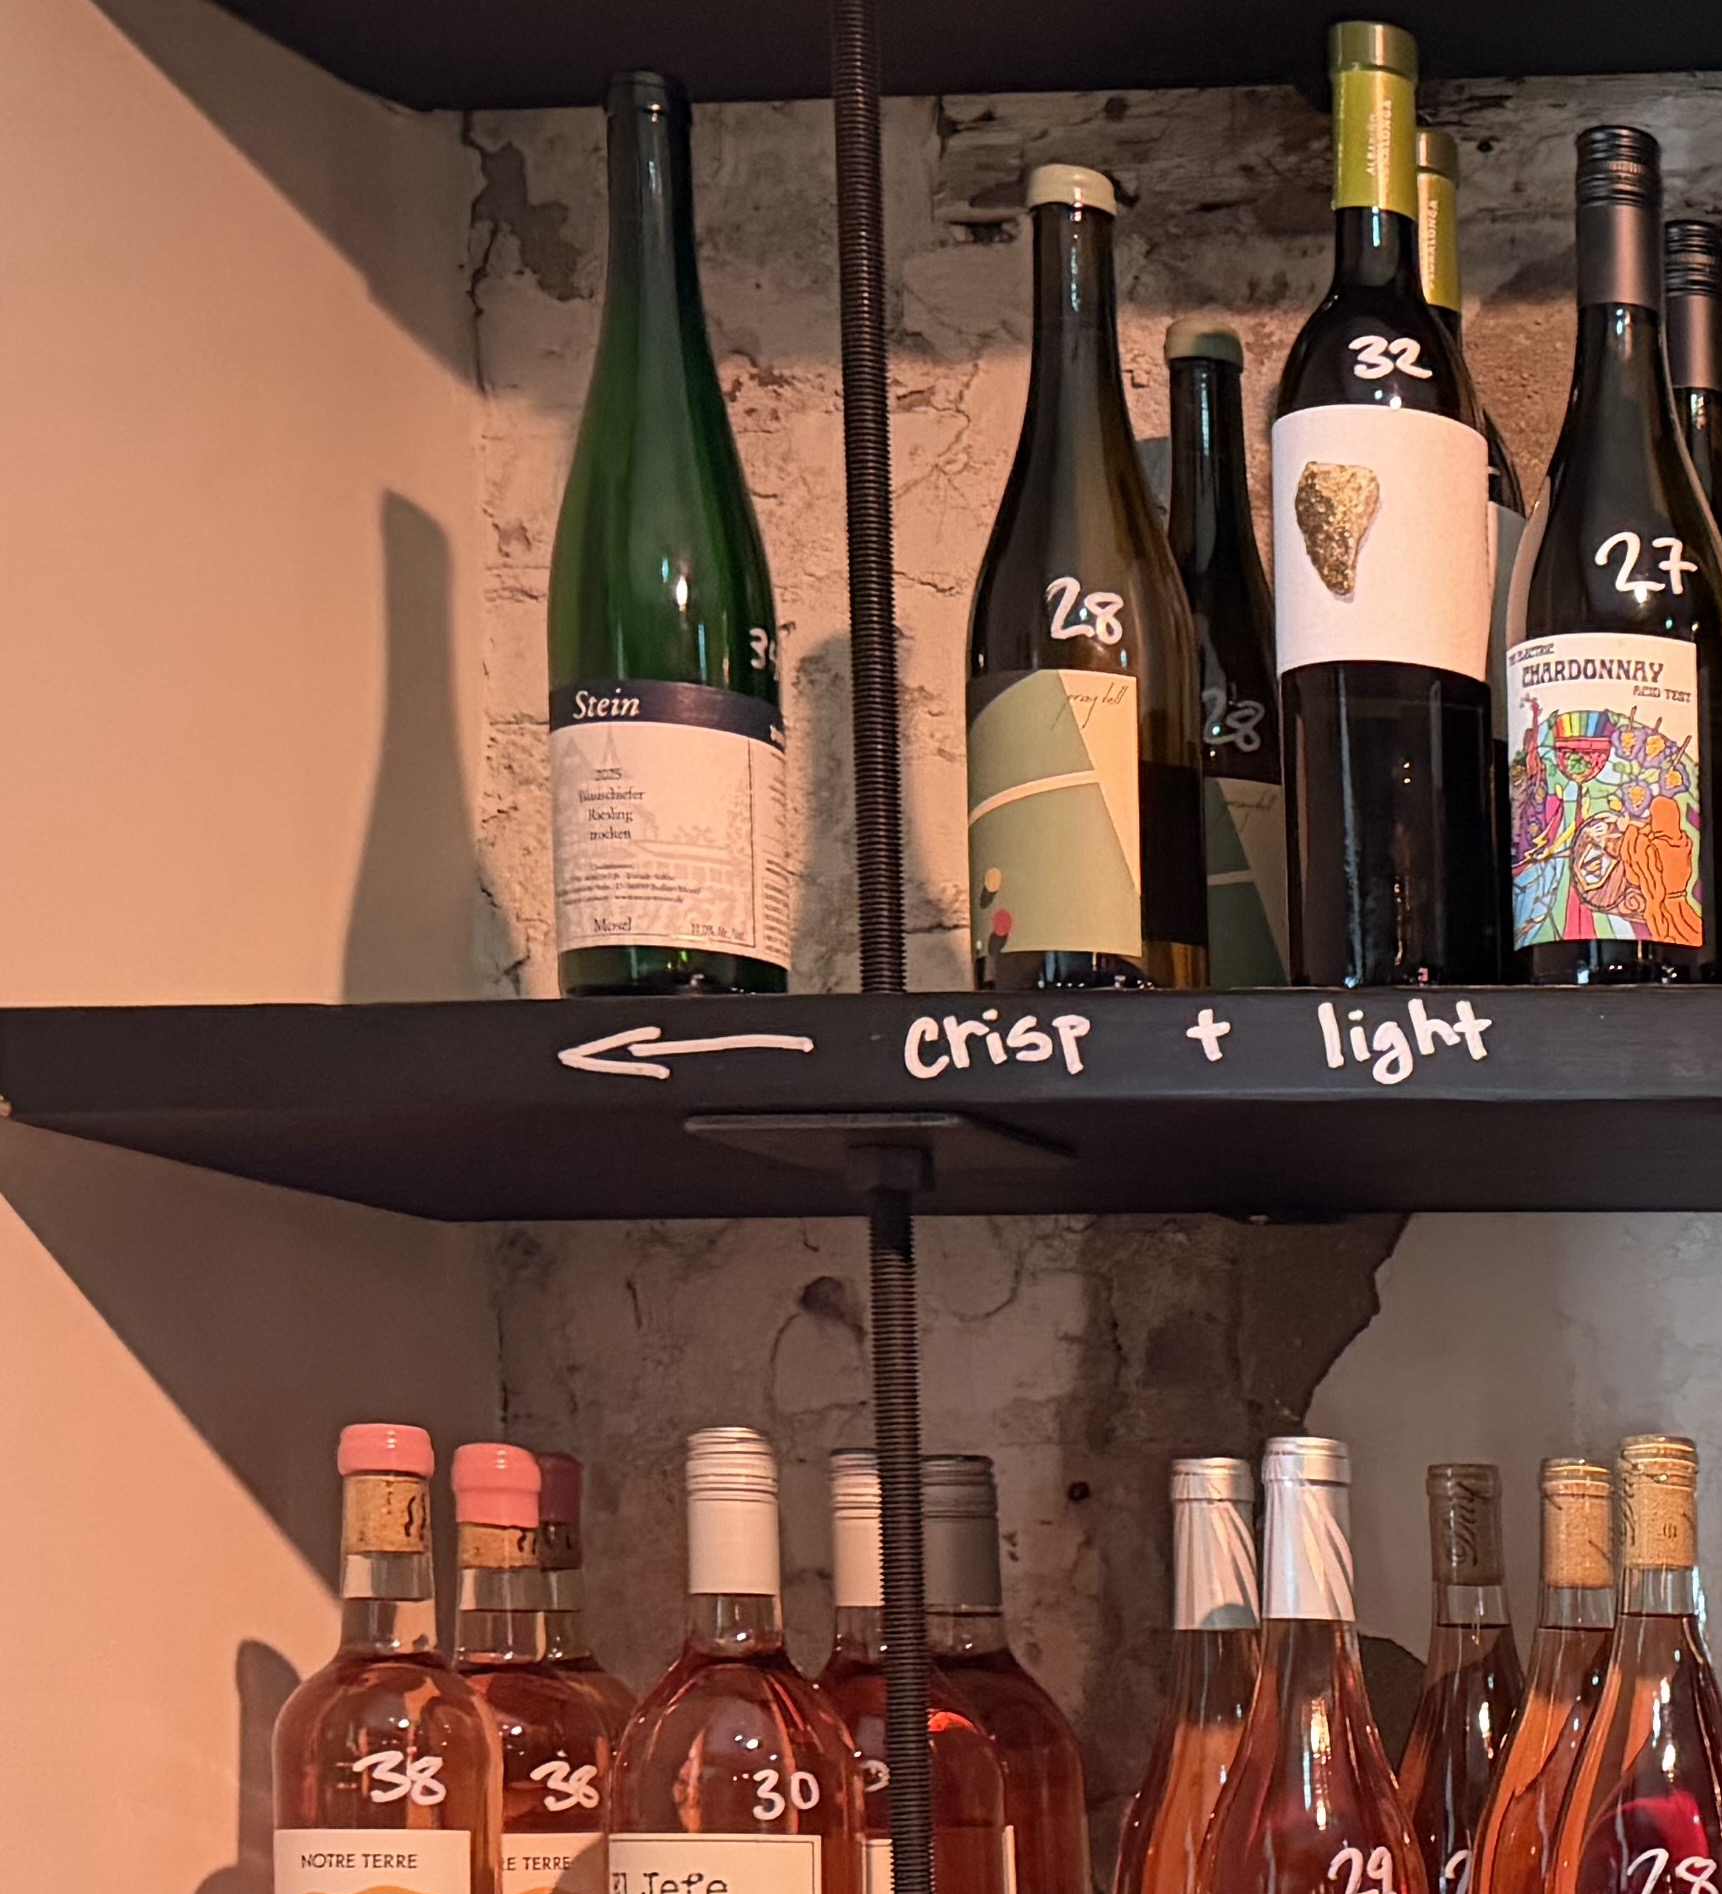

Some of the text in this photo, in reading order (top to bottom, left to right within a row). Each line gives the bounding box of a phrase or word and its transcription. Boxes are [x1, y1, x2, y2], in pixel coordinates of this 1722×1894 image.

[1349, 335, 1433, 380] 32
[1595, 531, 1698, 595] 27
[1046, 576, 1124, 646] 28
[1521, 660, 1664, 688] CHARDONNAY
[1633, 685, 1692, 703] ACID TEST
[571, 687, 641, 720] Stein
[1201, 687, 1266, 753] 28
[593, 916, 633, 935] Mosel
[905, 1001, 1493, 1086] crisp + light
[352, 1750, 447, 1807] 38
[530, 1760, 600, 1812] 38
[753, 1769, 821, 1821] 30
[301, 1853, 419, 1869] NOTRE TERRE
[524, 1856, 572, 1871] TERRE
